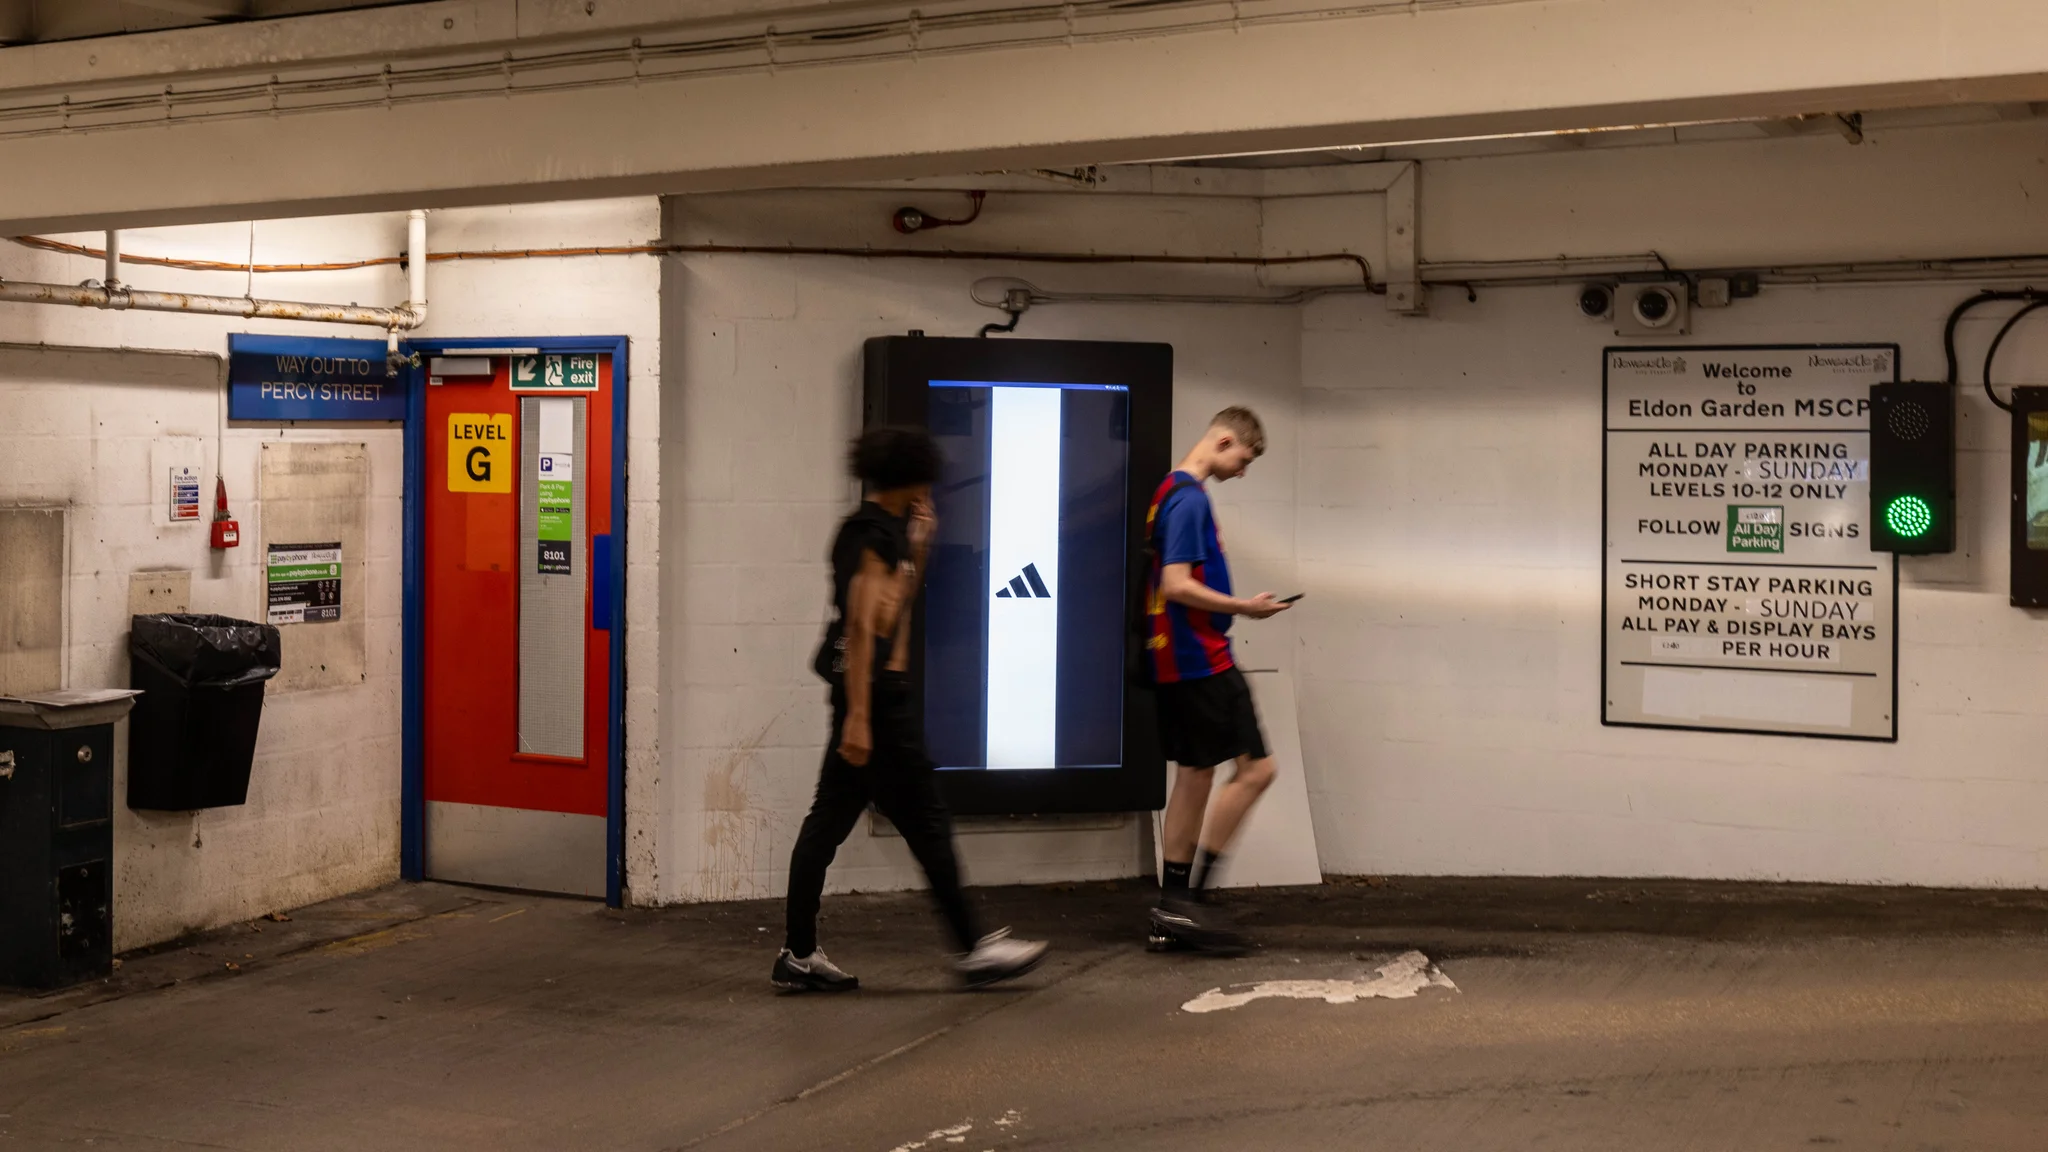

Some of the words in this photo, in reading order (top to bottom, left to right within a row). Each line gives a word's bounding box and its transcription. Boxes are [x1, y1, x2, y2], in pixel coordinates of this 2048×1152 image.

[276, 355, 308, 373] WAY
[311, 356, 345, 375] OUT
[345, 358, 370, 376] TO
[570, 357, 594, 370] Fire
[1702, 362, 1793, 379] Welcome
[570, 372, 594, 385] exit
[261, 382, 317, 400] PERCY
[320, 383, 383, 401] STREET
[1737, 380, 1756, 396] to
[1628, 399, 1693, 417] Eldon
[1701, 399, 1785, 417] Garden
[1795, 399, 1871, 417] MSCP
[454, 424, 506, 440] LEVEL
[1648, 442, 1688, 459] ALL
[1695, 442, 1736, 459] DAY
[1744, 442, 1848, 459] PARKING
[465, 446, 491, 482] G
[1638, 462, 1728, 478] MONDAY
[1758, 460, 1859, 480] SUNDAY
[1649, 482, 1725, 497] LEVELS
[1732, 483, 1783, 499] 10-12
[1789, 484, 1847, 499] ONLY
[1638, 519, 1721, 535] FOLLOW
[1789, 522, 1860, 538] SIGNS
[1734, 523, 1751, 535] All
[1753, 523, 1778, 538] Day
[1732, 535, 1780, 551] Parking
[277, 554, 308, 563] paybyphone
[543, 550, 566, 561] 8101
[1625, 573, 1700, 591] SHORT
[1707, 576, 1760, 592] STAY
[1768, 578, 1873, 597] PARKING
[321, 609, 337, 618] 8101
[1638, 596, 1728, 613] MONDAY
[1760, 599, 1860, 620] SUNDAY
[1621, 617, 1658, 632] ALL
[1664, 618, 1700, 633] PAY
[1707, 619, 1719, 634] &
[1727, 621, 1815, 638] DISPLAY
[1821, 625, 1876, 641] BAYS
[1722, 641, 1762, 657] PER
[1770, 643, 1830, 659] HOUR
